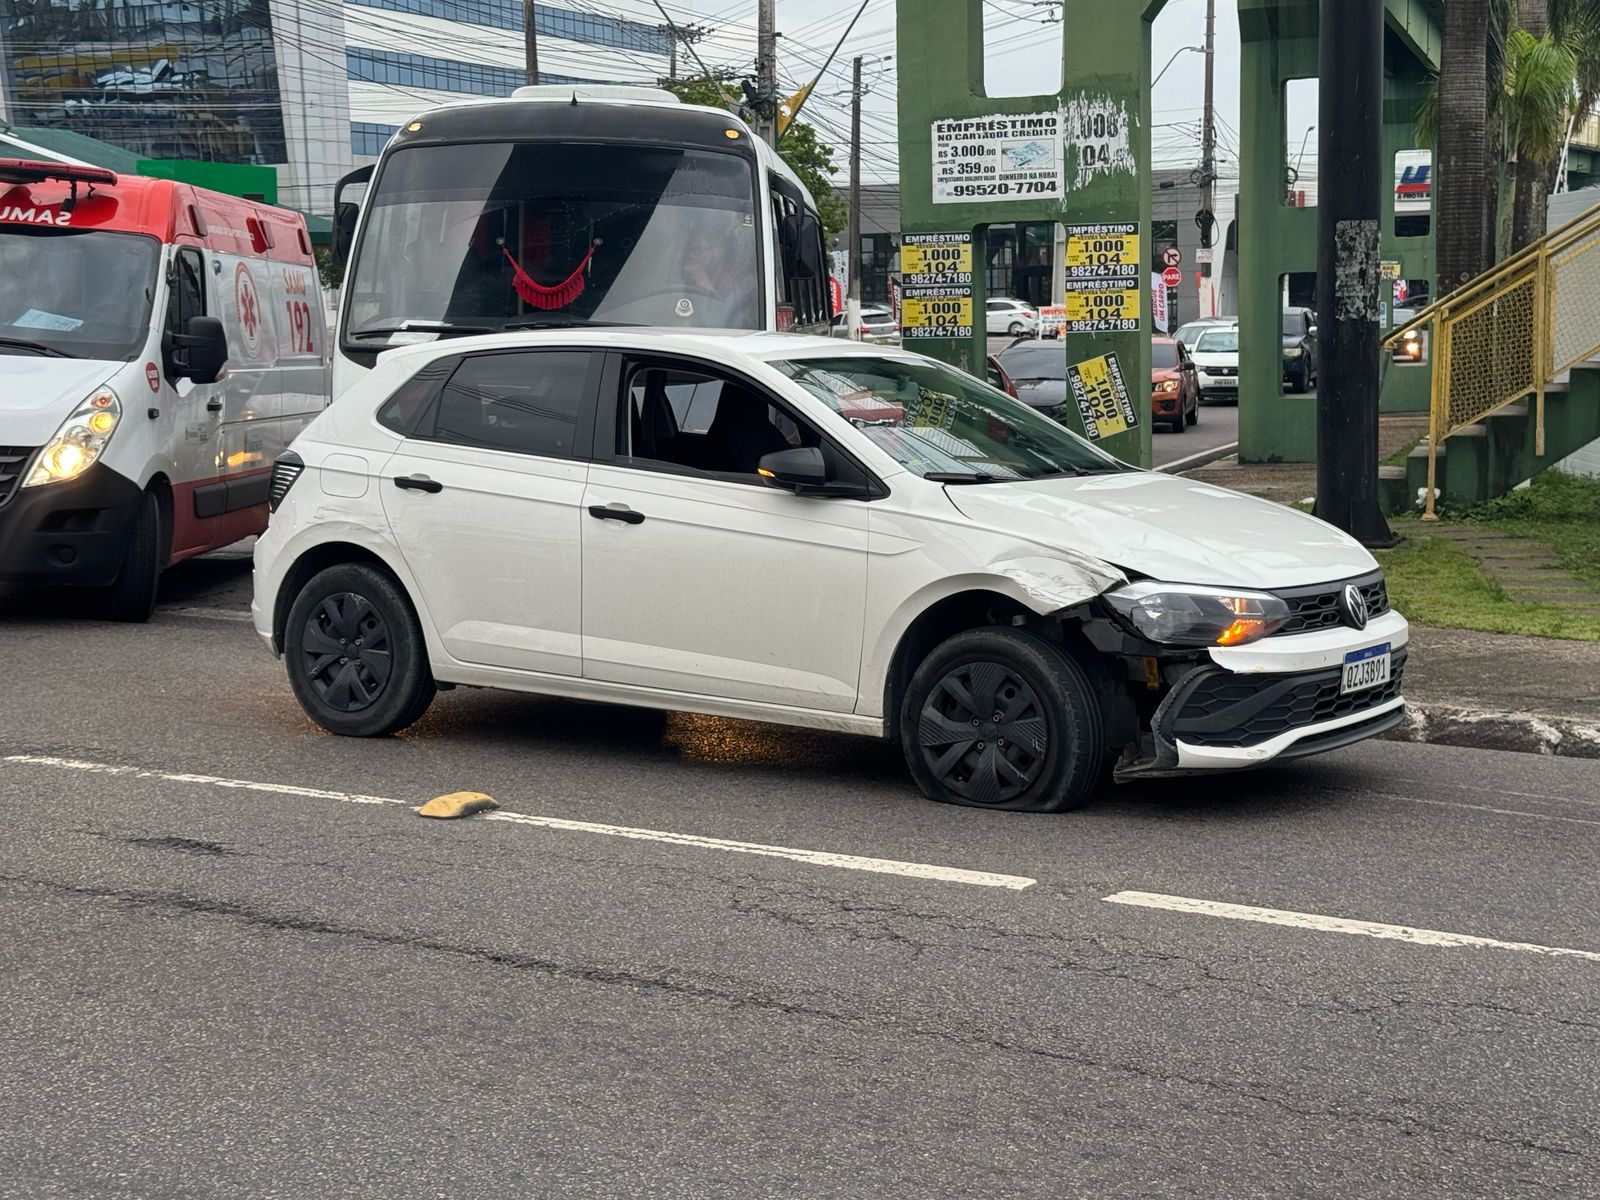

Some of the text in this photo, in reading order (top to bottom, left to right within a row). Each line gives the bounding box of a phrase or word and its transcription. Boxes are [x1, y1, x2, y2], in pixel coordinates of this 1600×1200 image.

[937, 118, 1057, 133] EMPRÉSTIMO
[1012, 128, 1057, 137] CRÉDITO
[999, 173, 1028, 181] DINHEIRO
[1029, 172, 1037, 180] NA
[953, 181, 1058, 197] 99520-7704
[905, 234, 970, 243] EMPRÉSTIMO
[1083, 240, 1124, 253] 1.000
[921, 248, 961, 261] 1.000
[1085, 253, 1121, 265] 104
[923, 261, 958, 273] 104
[1071, 264, 1135, 277] 98274-7180
[283, 267, 306, 296] SAMU
[910, 272, 972, 284] 98274-7180
[1066, 279, 1135, 290] EMPRÉSTIMO
[906, 288, 971, 297] EMPRÉSTIMO
[1083, 294, 1125, 307] 1.000
[922, 302, 961, 315] 1.000
[1086, 308, 1122, 320] 104
[286, 301, 314, 352] 192
[924, 315, 959, 327] 104
[1071, 319, 1136, 331] 98274-7180
[911, 326, 972, 337] 98274-7180
[1107, 357, 1135, 424] EMPRÉSTIMO
[1086, 384, 1105, 421] 104
[1096, 378, 1118, 419] 1.000
[1071, 374, 1099, 437] 98274-7180
[1347, 657, 1386, 689] QZJ3B91
